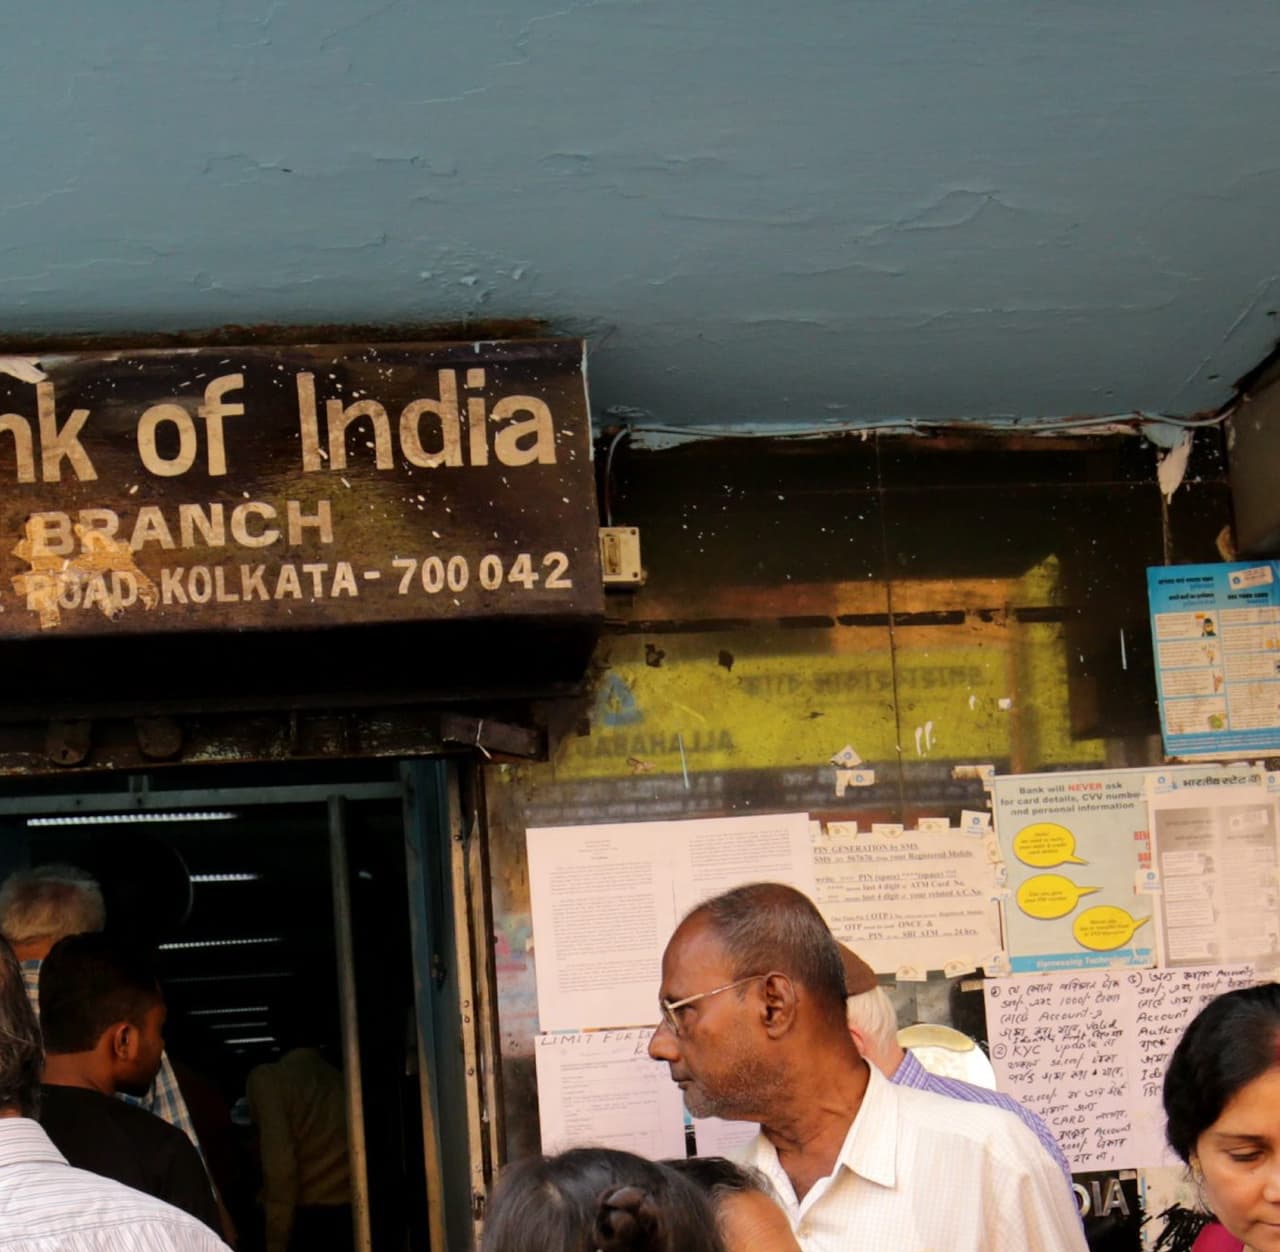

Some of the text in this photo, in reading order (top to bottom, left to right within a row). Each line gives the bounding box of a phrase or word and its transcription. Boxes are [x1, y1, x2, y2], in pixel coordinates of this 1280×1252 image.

[136, 373, 246, 477] of
[295, 367, 558, 472] India
[26, 500, 334, 556] BRANCH
[1019, 782, 1122, 794] Bank will NEVER ask
[1000, 798, 1014, 806] for
[1017, 797, 1039, 805] card
[1082, 793, 1103, 801] CVV
[1010, 802, 1135, 816] and personal information
[1136, 1008, 1189, 1023] Account
[541, 1034, 594, 1046] LIMIT
[603, 1031, 632, 1043] FOR
[1013, 1045, 1041, 1058] KYC
[1052, 1114, 1086, 1126] CARD
